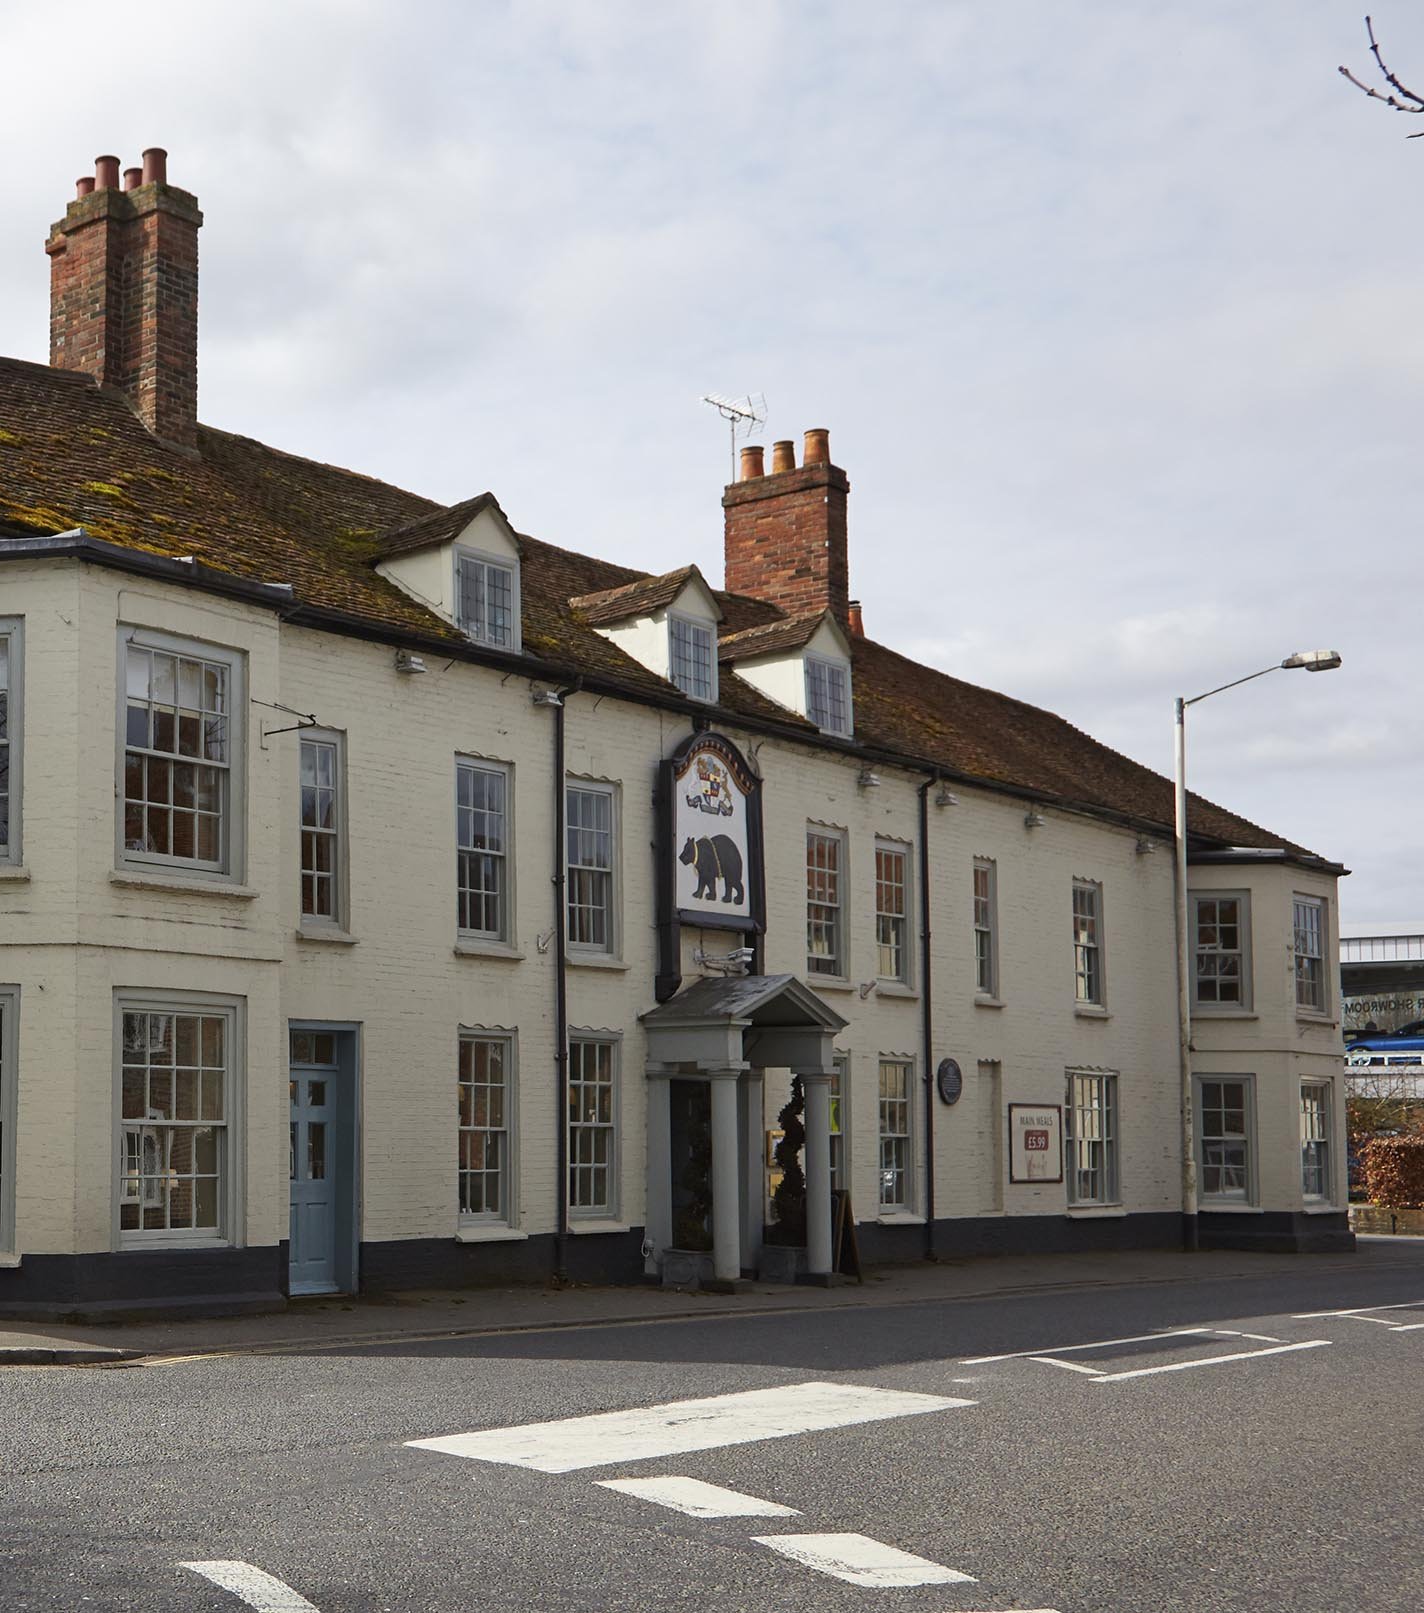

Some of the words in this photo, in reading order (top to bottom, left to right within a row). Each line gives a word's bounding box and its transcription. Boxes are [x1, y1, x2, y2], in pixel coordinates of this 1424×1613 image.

[1020, 1116, 1035, 1126] MAIN
[1036, 1116, 1053, 1126] MEALS
[1028, 1136, 1046, 1149] £5.99
